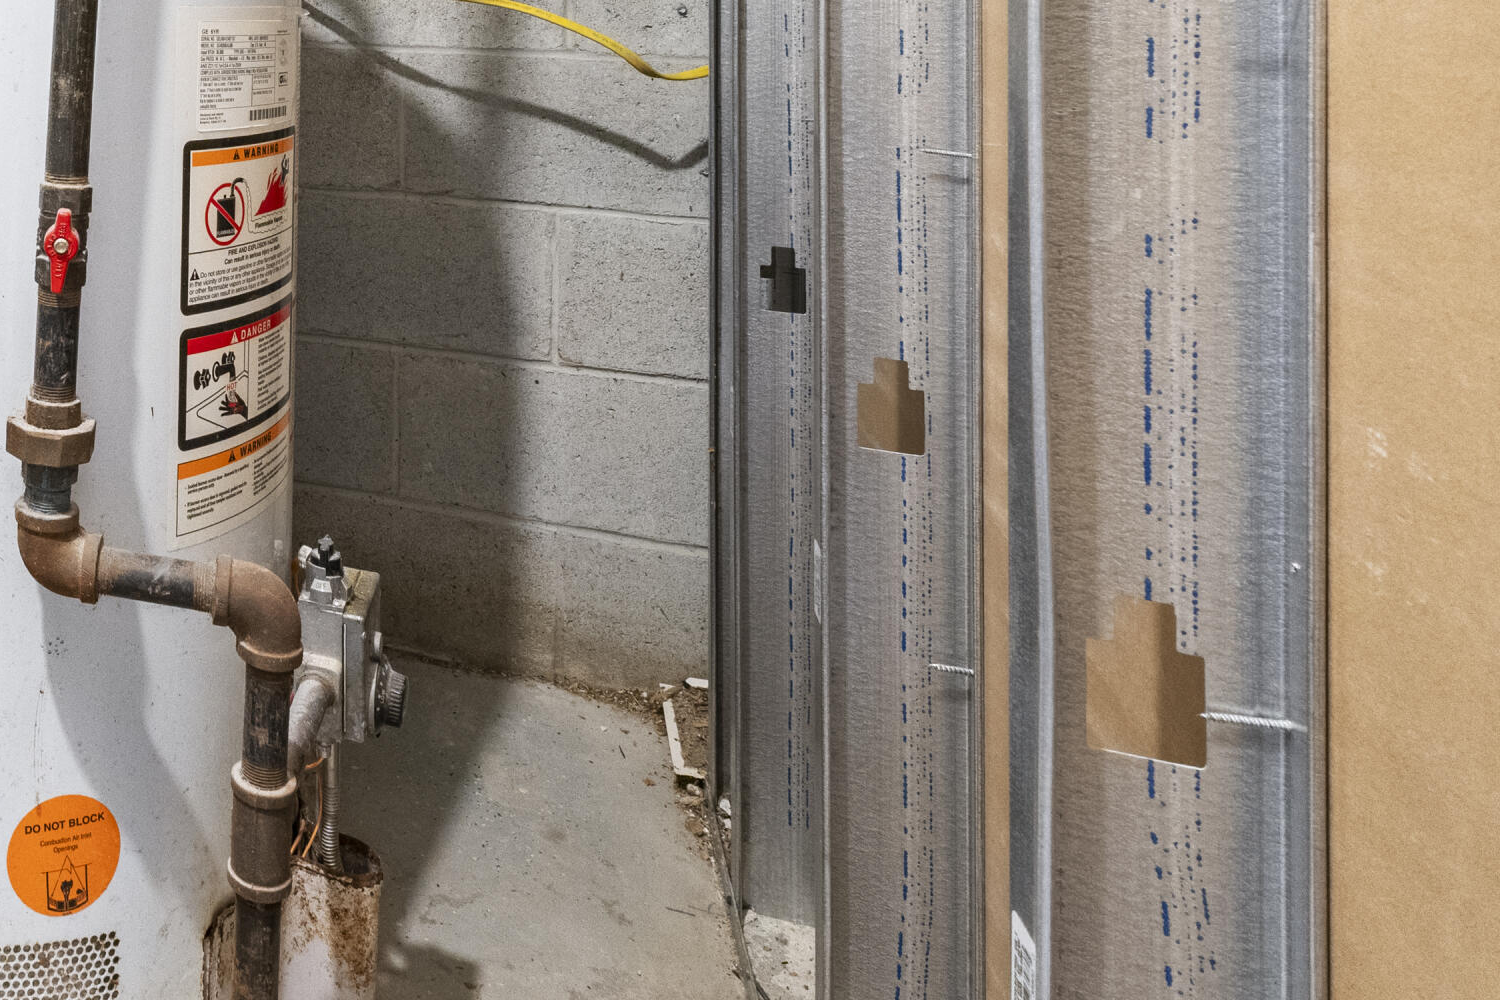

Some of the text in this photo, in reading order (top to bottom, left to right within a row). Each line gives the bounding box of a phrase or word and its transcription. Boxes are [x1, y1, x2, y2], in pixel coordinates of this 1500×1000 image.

[244, 143, 279, 159] WARNING
[248, 241, 267, 251] EXPLOSION
[200, 271, 207, 279] Do
[203, 278, 216, 286] vicinity
[208, 283, 228, 292] flammable
[240, 319, 271, 340] DANGER
[226, 381, 238, 392] HOT
[240, 432, 272, 457] WARNING
[25, 812, 105, 835] DO NOT BLOCK
[40, 836, 71, 848] Combustion
[81, 832, 92, 840] Inlet
[53, 843, 78, 854] Openings
